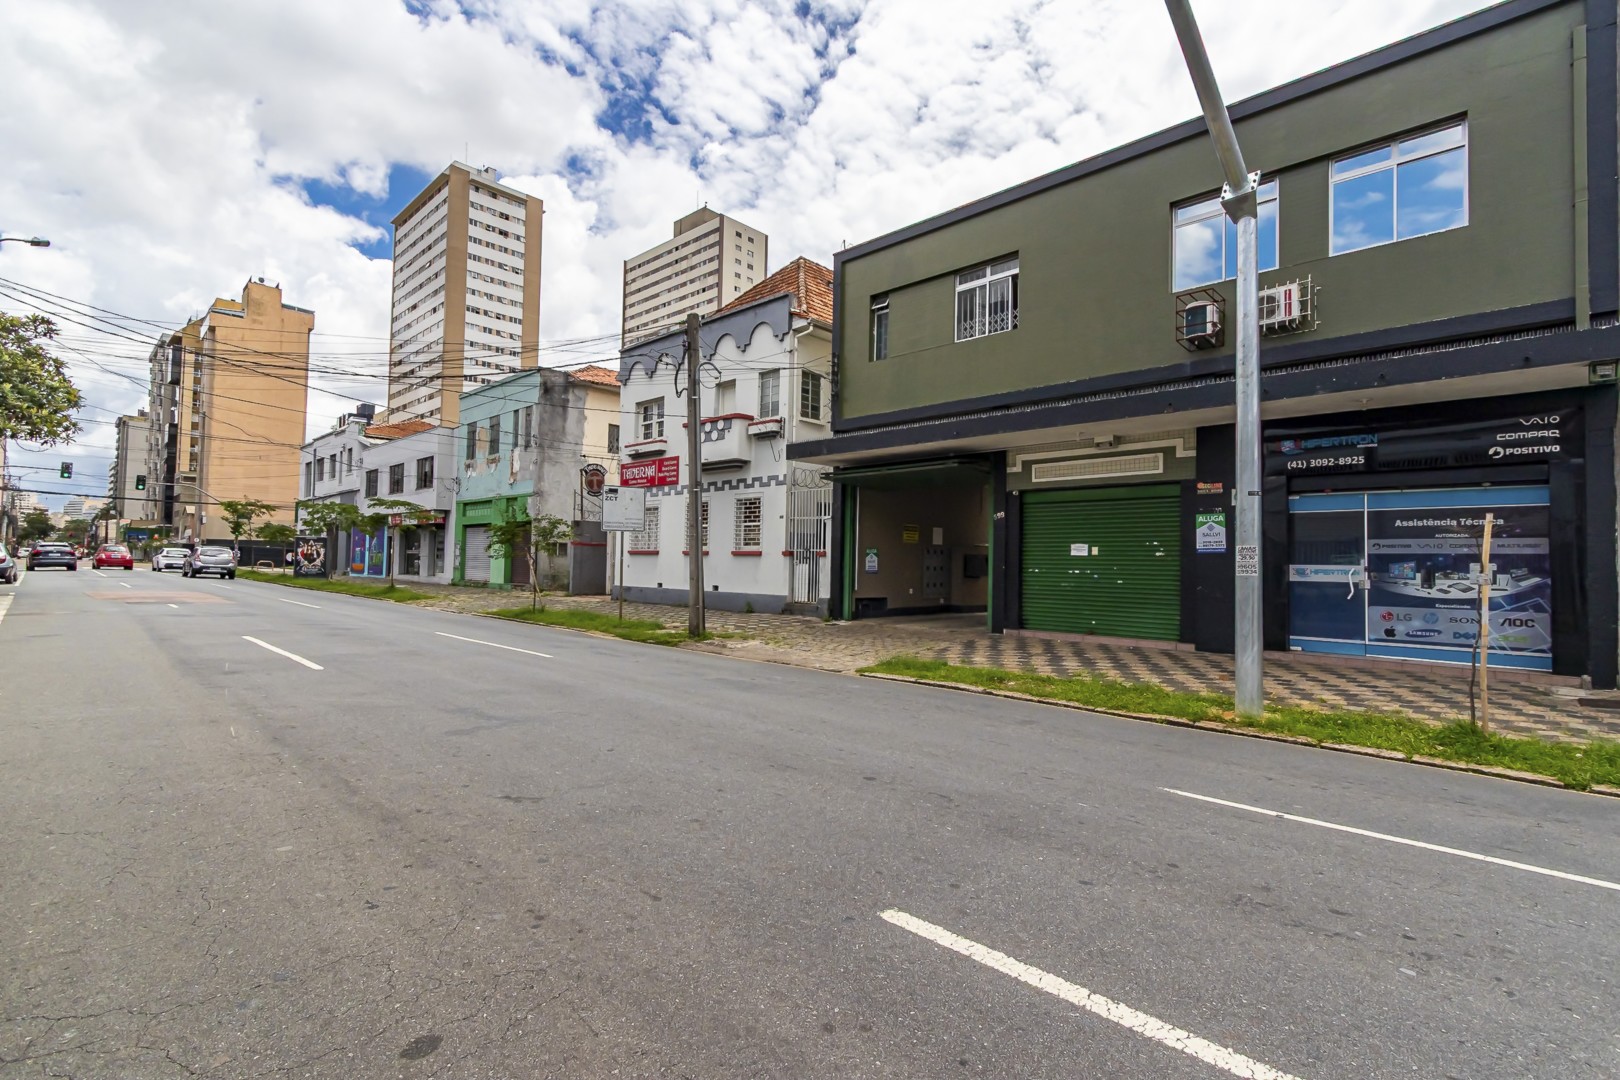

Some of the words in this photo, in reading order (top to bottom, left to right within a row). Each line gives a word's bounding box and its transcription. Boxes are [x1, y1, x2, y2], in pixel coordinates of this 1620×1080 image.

[1519, 415, 1560, 426] VAIO
[1301, 433, 1378, 448] HIPERTRON
[1496, 429, 1560, 441] COMPAQ
[1505, 445, 1560, 456] POSITIVO
[1287, 460, 1307, 470] (41)
[1309, 456, 1365, 467] 3092-8925
[622, 464, 656, 480] TAVERNA
[1394, 518, 1457, 527] Assistência
[1459, 517, 1504, 526] Técnca
[1396, 613, 1413, 622] LG
